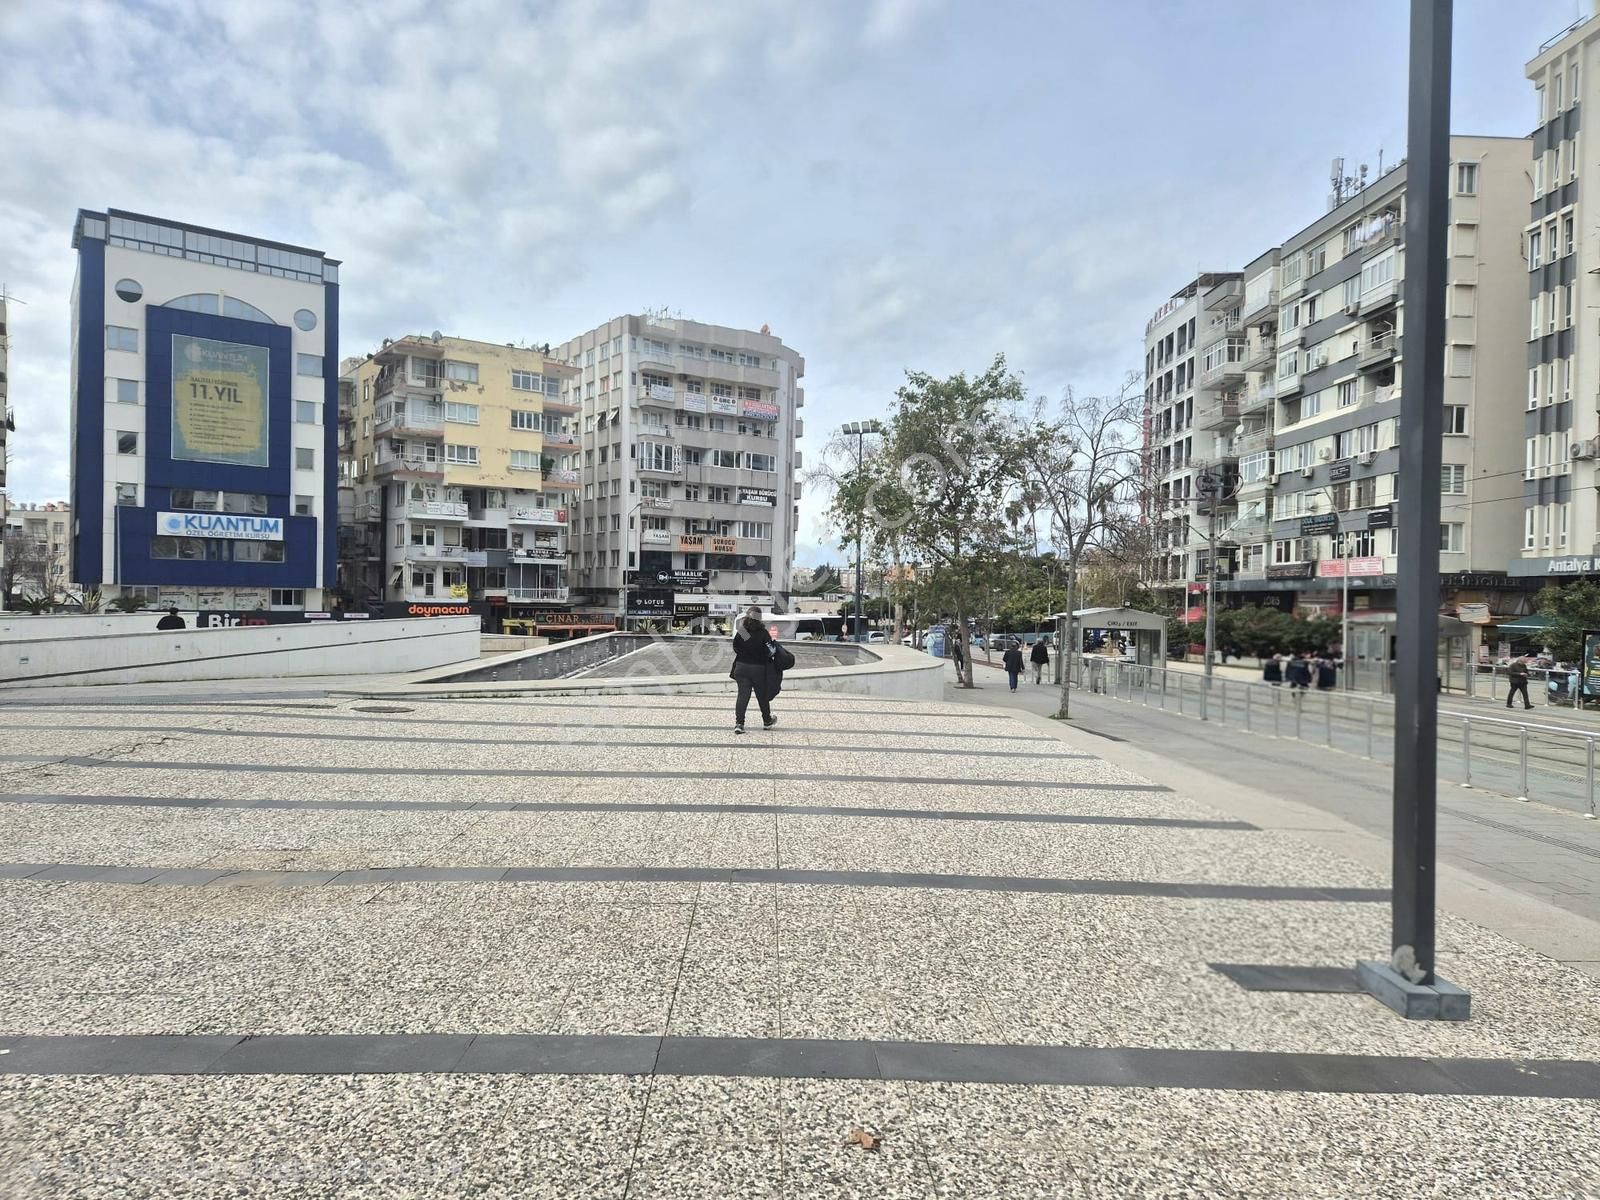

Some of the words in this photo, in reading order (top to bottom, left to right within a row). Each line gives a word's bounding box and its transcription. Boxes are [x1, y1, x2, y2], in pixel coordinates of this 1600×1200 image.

[184, 515, 280, 534] KUANTUM
[245, 532, 271, 540] KURSU
[680, 535, 703, 546] YAŞAM
[1548, 558, 1591, 574] Antalya
[408, 604, 471, 618] doymacun
[208, 613, 268, 628] Birim
